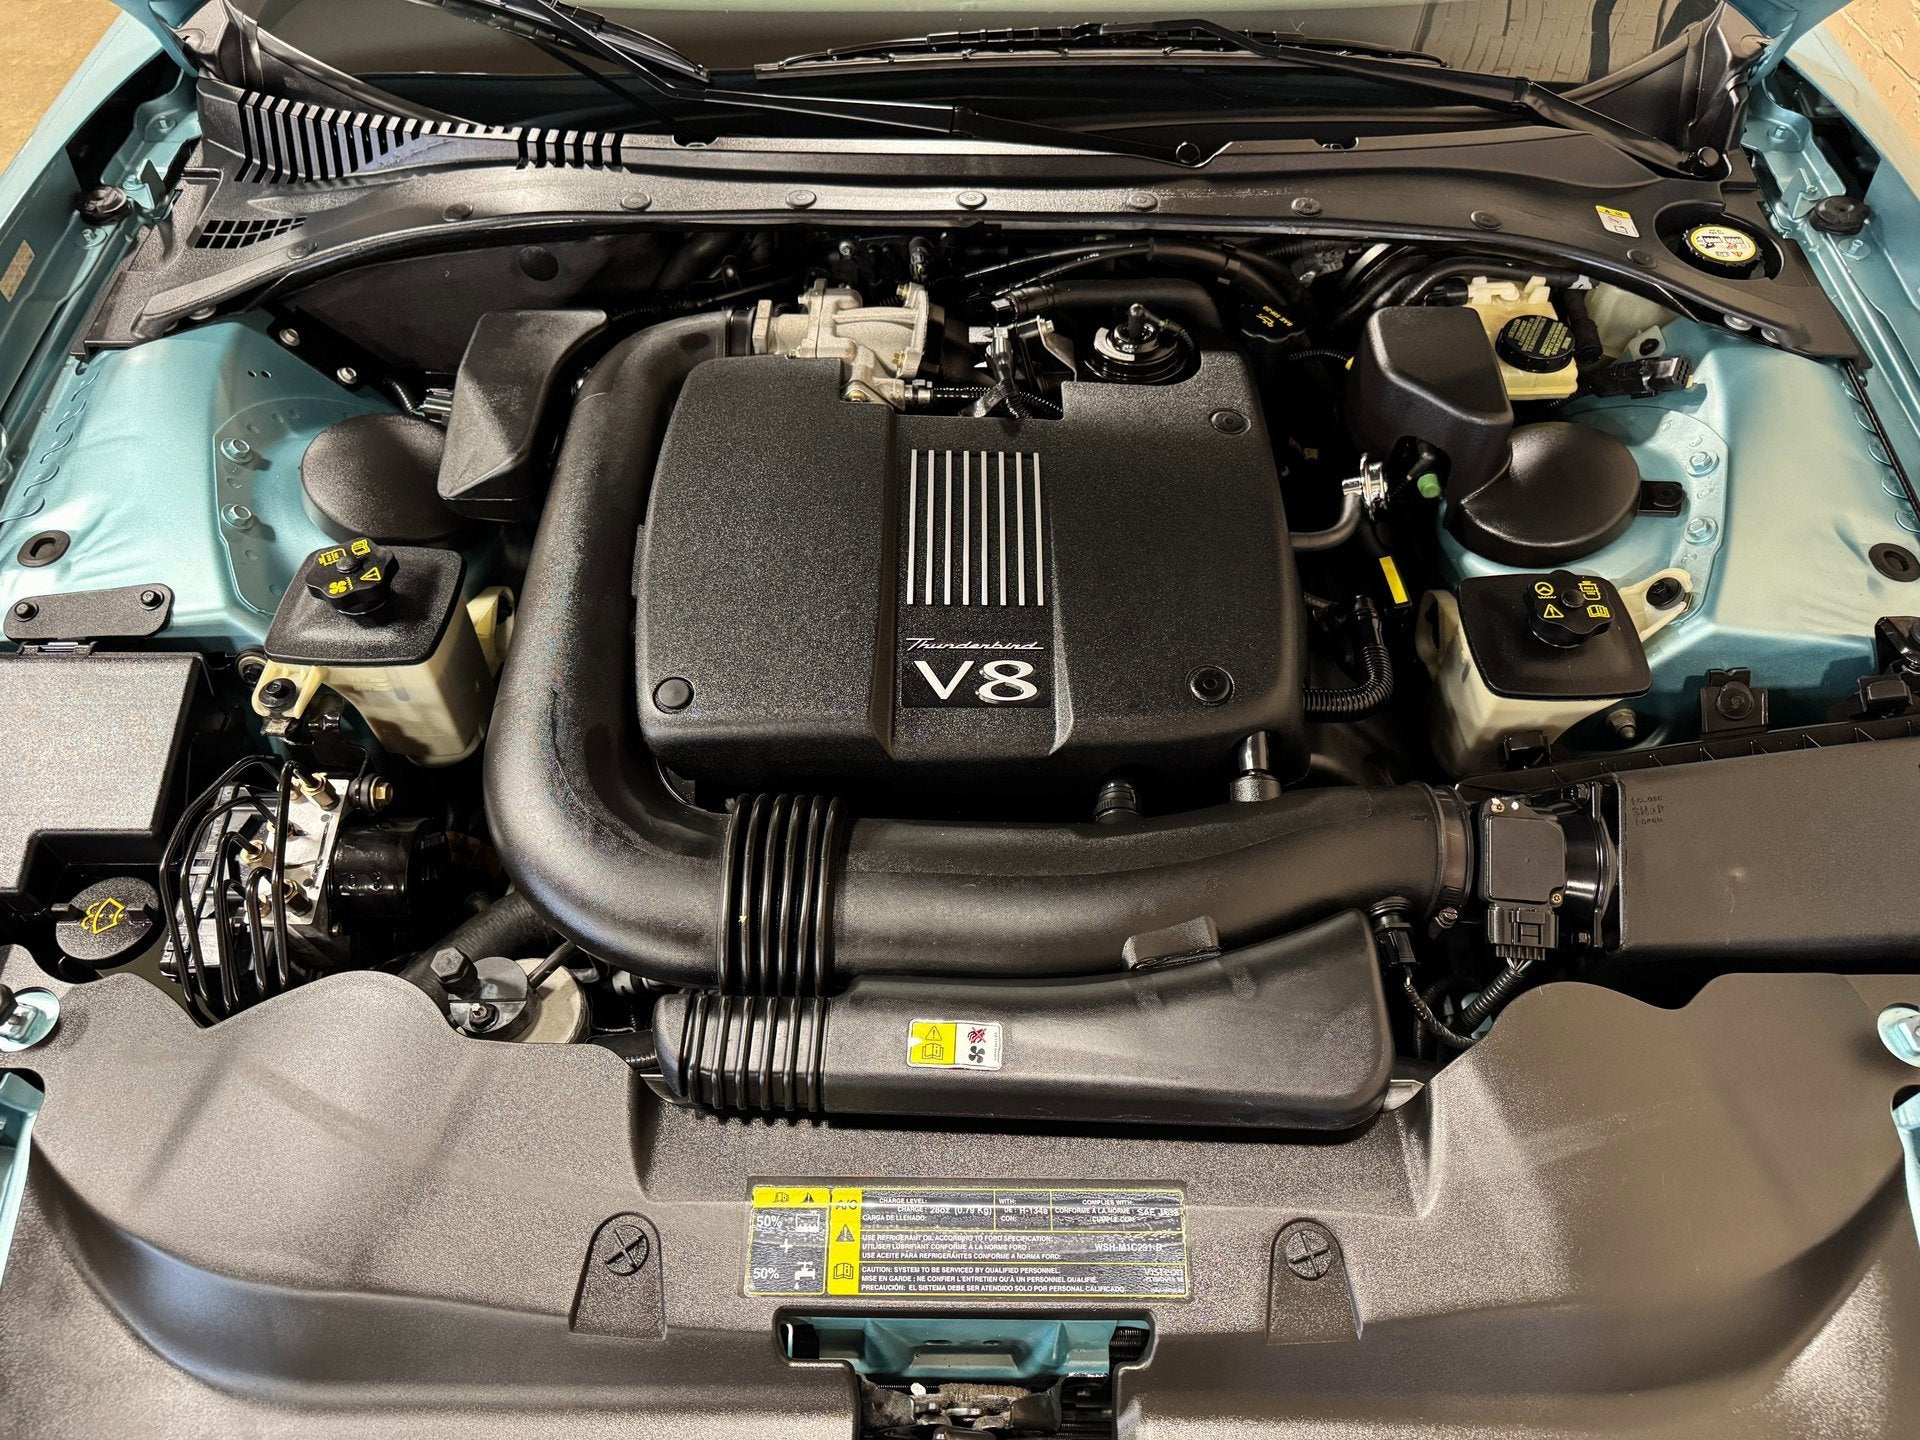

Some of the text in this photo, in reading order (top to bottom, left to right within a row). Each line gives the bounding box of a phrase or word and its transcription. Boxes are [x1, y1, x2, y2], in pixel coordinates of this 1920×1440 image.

[905, 637, 1044, 651] Thunderbird
[913, 660, 1039, 703] V8
[835, 1199, 858, 1211] A/C
[954, 1206, 976, 1216] (0.79
[977, 1206, 992, 1216] Kg)
[1019, 1207, 1049, 1215] R-134a
[1054, 1206, 1090, 1214] CONFORME
[1137, 1208, 1156, 1216] SAE
[756, 1215, 783, 1228] 50%
[753, 1267, 780, 1280] 50%
[956, 1275, 998, 1283] L'ENTRETIEN
[998, 1274, 1015, 1283] QU'À
[861, 1283, 906, 1291] PRECAUCIÓN:
